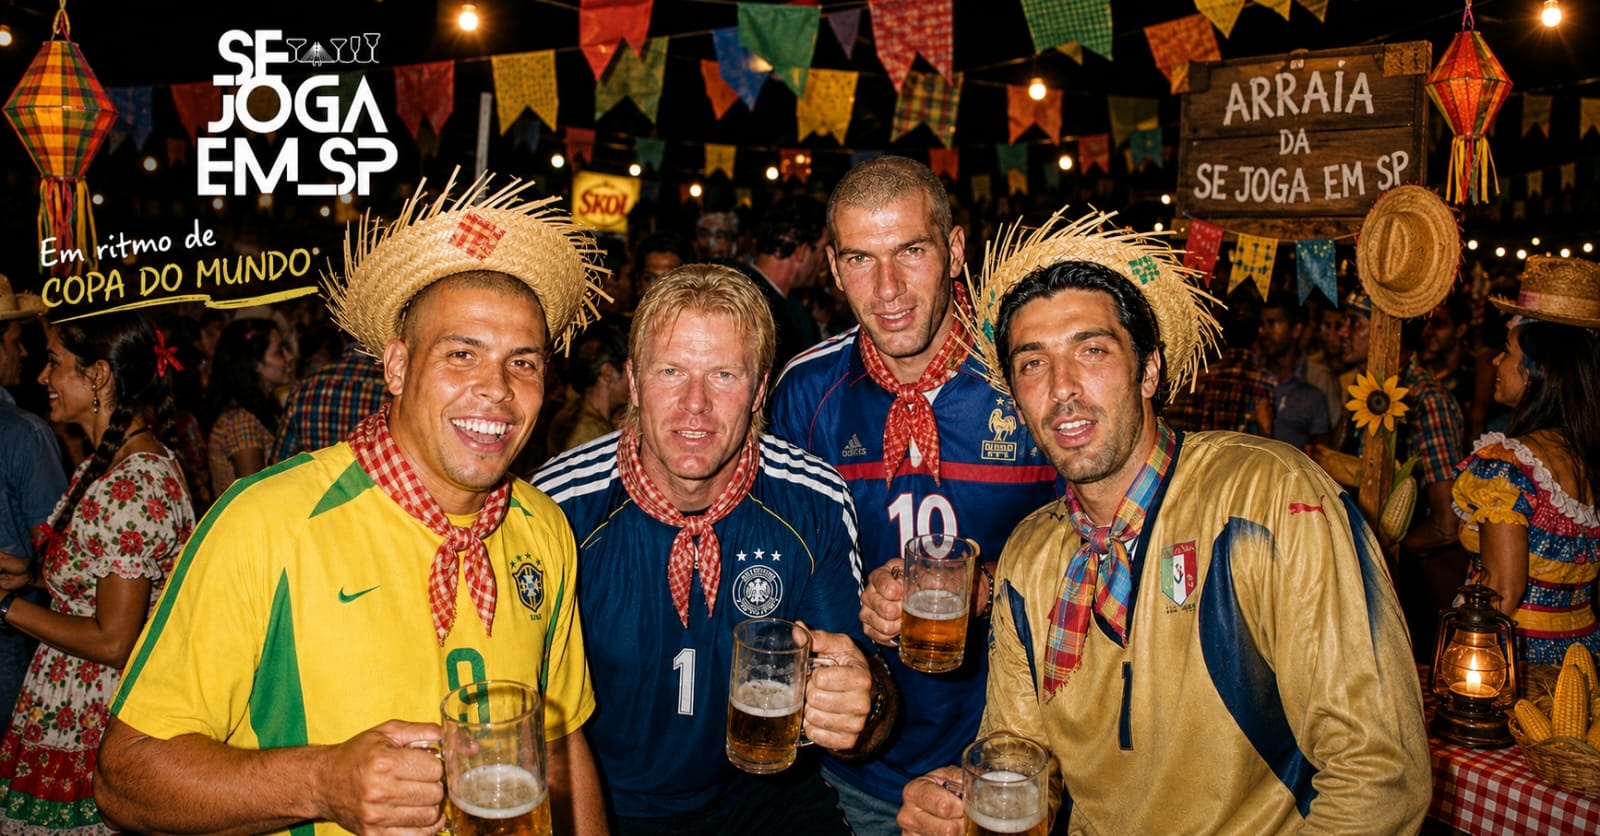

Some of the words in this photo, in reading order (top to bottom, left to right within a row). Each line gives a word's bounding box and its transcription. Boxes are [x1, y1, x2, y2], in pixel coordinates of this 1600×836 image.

[1279, 128, 1311, 156] DA
[579, 189, 628, 217] SKOL
[1194, 163, 1228, 200] SE
[1235, 166, 1310, 204] JOGA
[1323, 161, 1366, 201] EM
[1376, 151, 1409, 191] SP
[887, 492, 958, 560] 10
[446, 647, 491, 738] 9
[673, 648, 696, 716] 1
